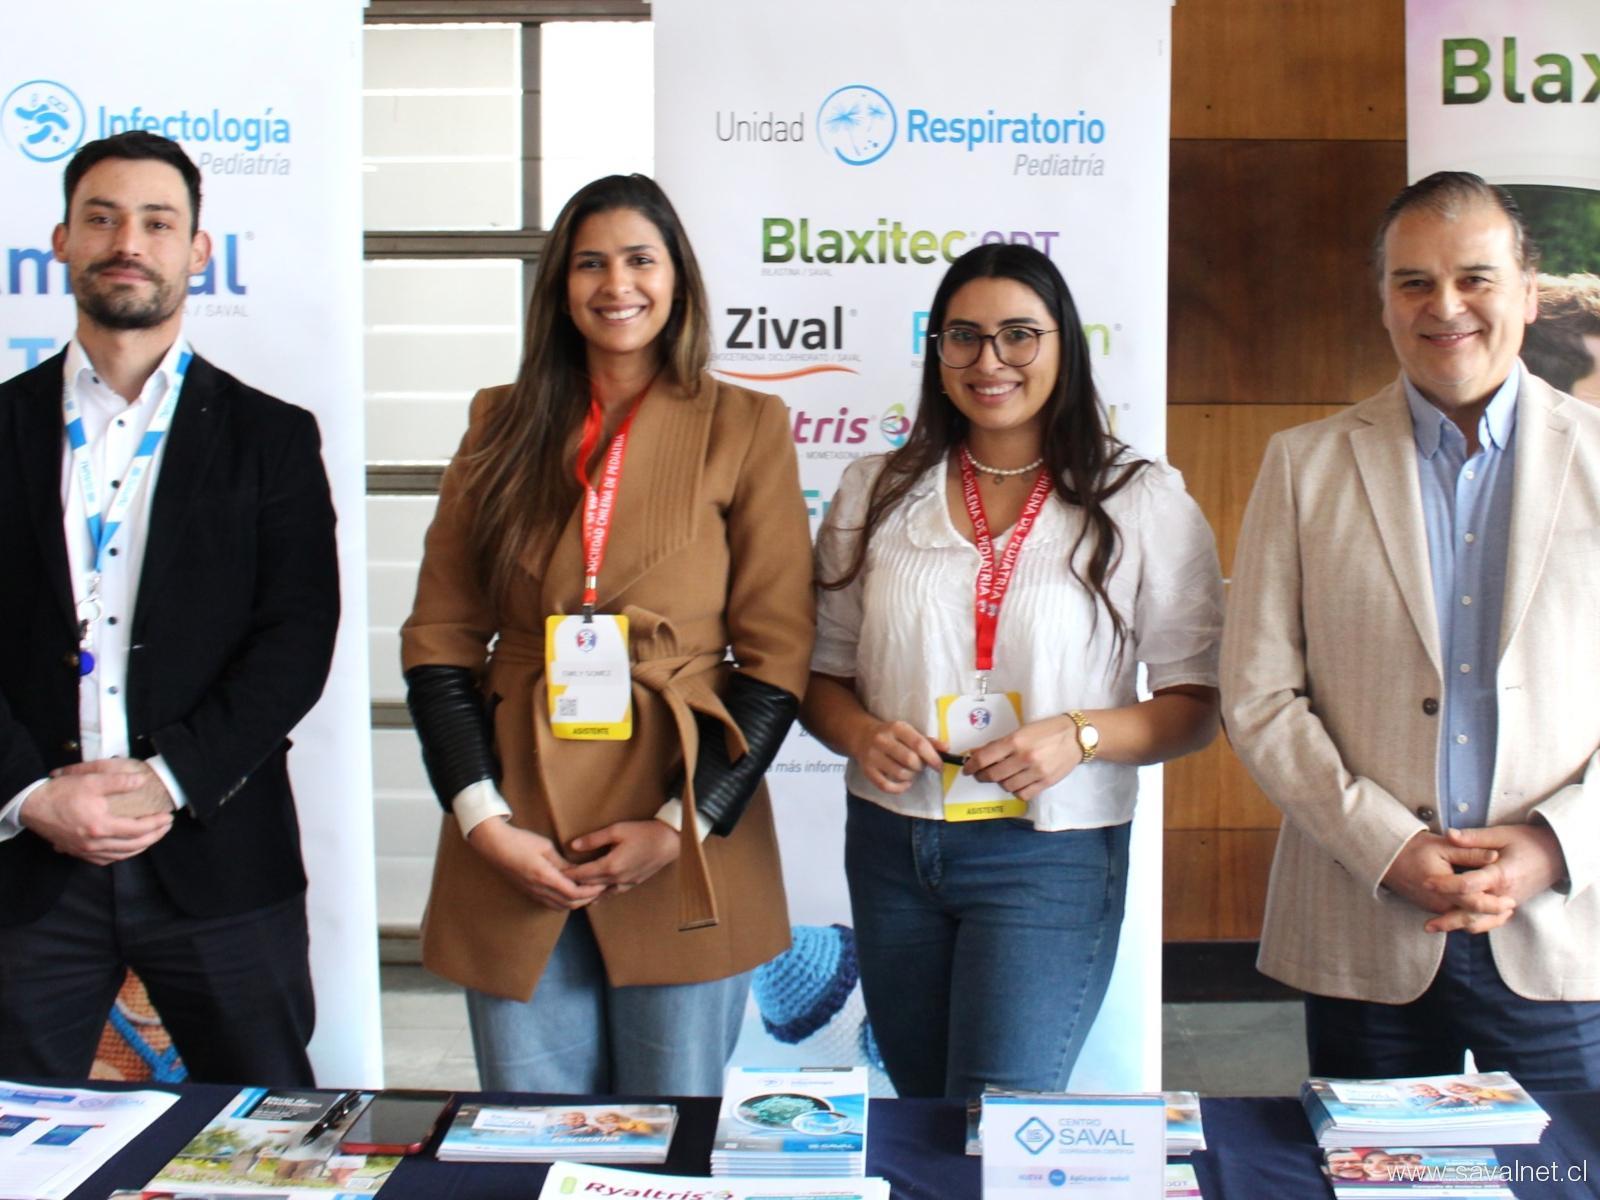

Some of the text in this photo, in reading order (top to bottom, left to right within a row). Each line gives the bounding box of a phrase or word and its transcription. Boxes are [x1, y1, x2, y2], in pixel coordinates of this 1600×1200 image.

[99, 105, 290, 151] Infectología
[716, 109, 1105, 150] Unidad Respiratorio
[199, 152, 291, 176] Pediatría
[1013, 153, 1105, 177] Pediatría
[762, 217, 967, 264] Blaxitec
[205, 304, 249, 317] SAVAL
[726, 306, 843, 350] Zival
[974, 518, 986, 536] DE
[989, 471, 1050, 600] HILENA DE PEDIATRIA
[976, 534, 994, 597] PEDIATRIA
[775, 759, 802, 773] más
[1058, 1118, 1101, 1127] CENTRO
[1058, 1128, 1135, 1146] SAVAL
[584, 1181, 703, 1200] Ryaltris
